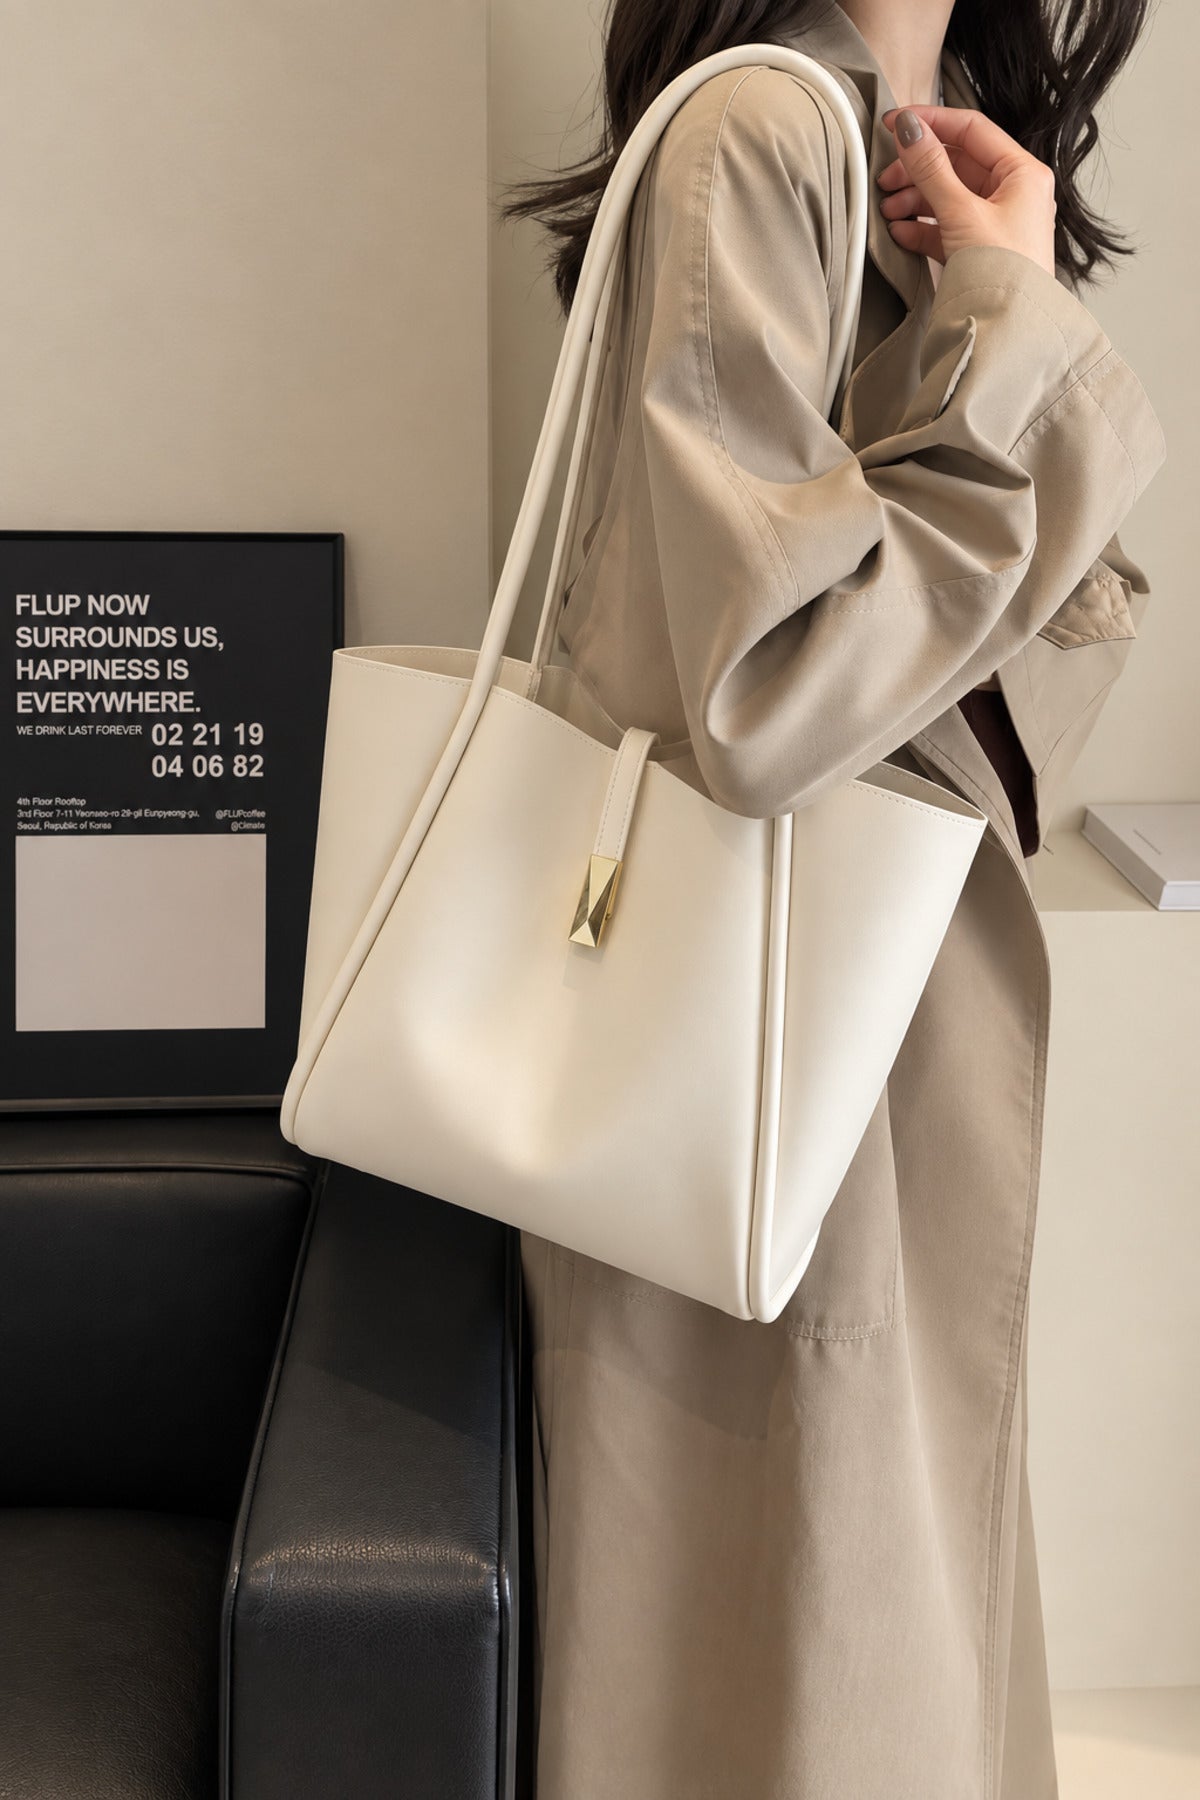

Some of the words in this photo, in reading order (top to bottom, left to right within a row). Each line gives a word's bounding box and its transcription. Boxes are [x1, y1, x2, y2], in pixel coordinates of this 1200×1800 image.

[16, 594, 81, 616] FLUP
[88, 594, 150, 616] NOW
[16, 626, 177, 648] SURROUNDS
[184, 626, 224, 651] US,
[17, 658, 160, 680] HAPPINESS
[167, 658, 189, 680] IS
[17, 691, 201, 713] EVERYWHERE.
[16, 725, 33, 735] WE
[35, 725, 66, 735] DRINK
[68, 725, 94, 735] LAST
[96, 725, 142, 735] FOREVER
[151, 723, 183, 746] 02
[192, 723, 220, 746] 21
[234, 723, 264, 746] 19
[151, 755, 183, 778] 04
[192, 755, 224, 778] 06
[233, 755, 264, 778] 82
[16, 797, 30, 806] 4th
[32, 797, 53, 806] Floor
[33, 809, 54, 818] Floor
[55, 809, 73, 818] 7-11
[79, 821, 88, 830] of
